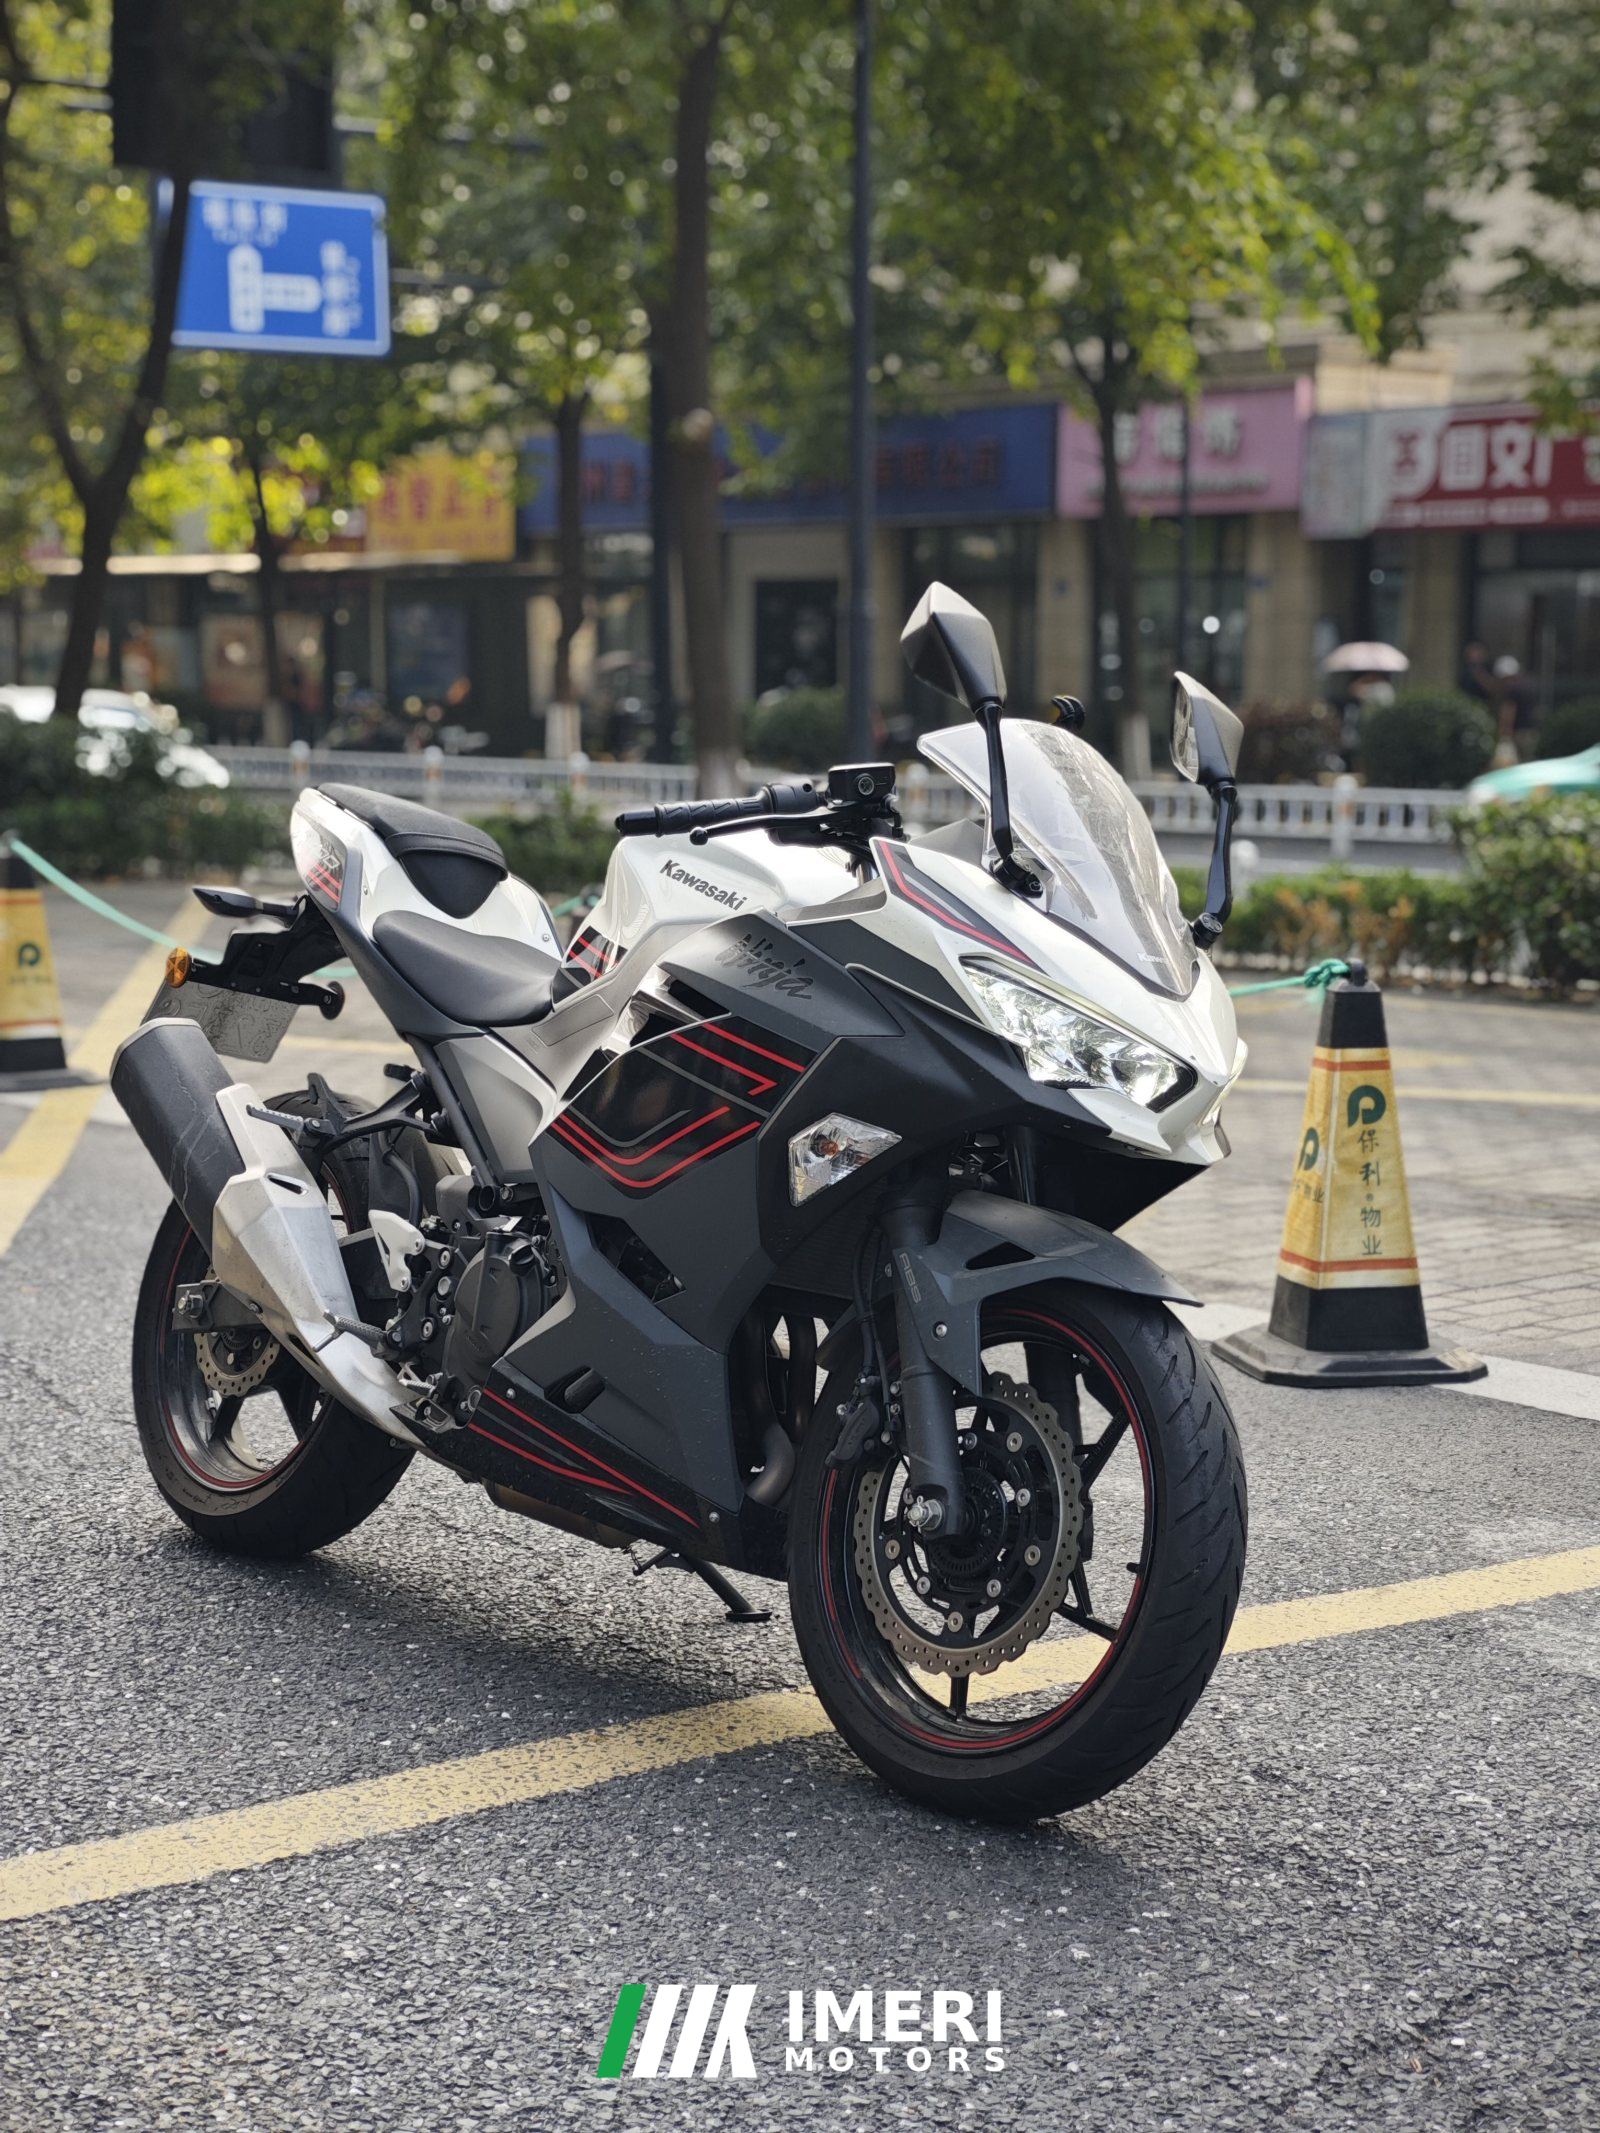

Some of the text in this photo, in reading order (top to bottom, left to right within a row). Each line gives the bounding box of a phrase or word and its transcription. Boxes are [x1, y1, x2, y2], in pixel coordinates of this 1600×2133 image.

[660, 859, 748, 911] Kawasaki
[715, 933, 814, 1000] Ninja
[899, 1252, 921, 1304] ABS
